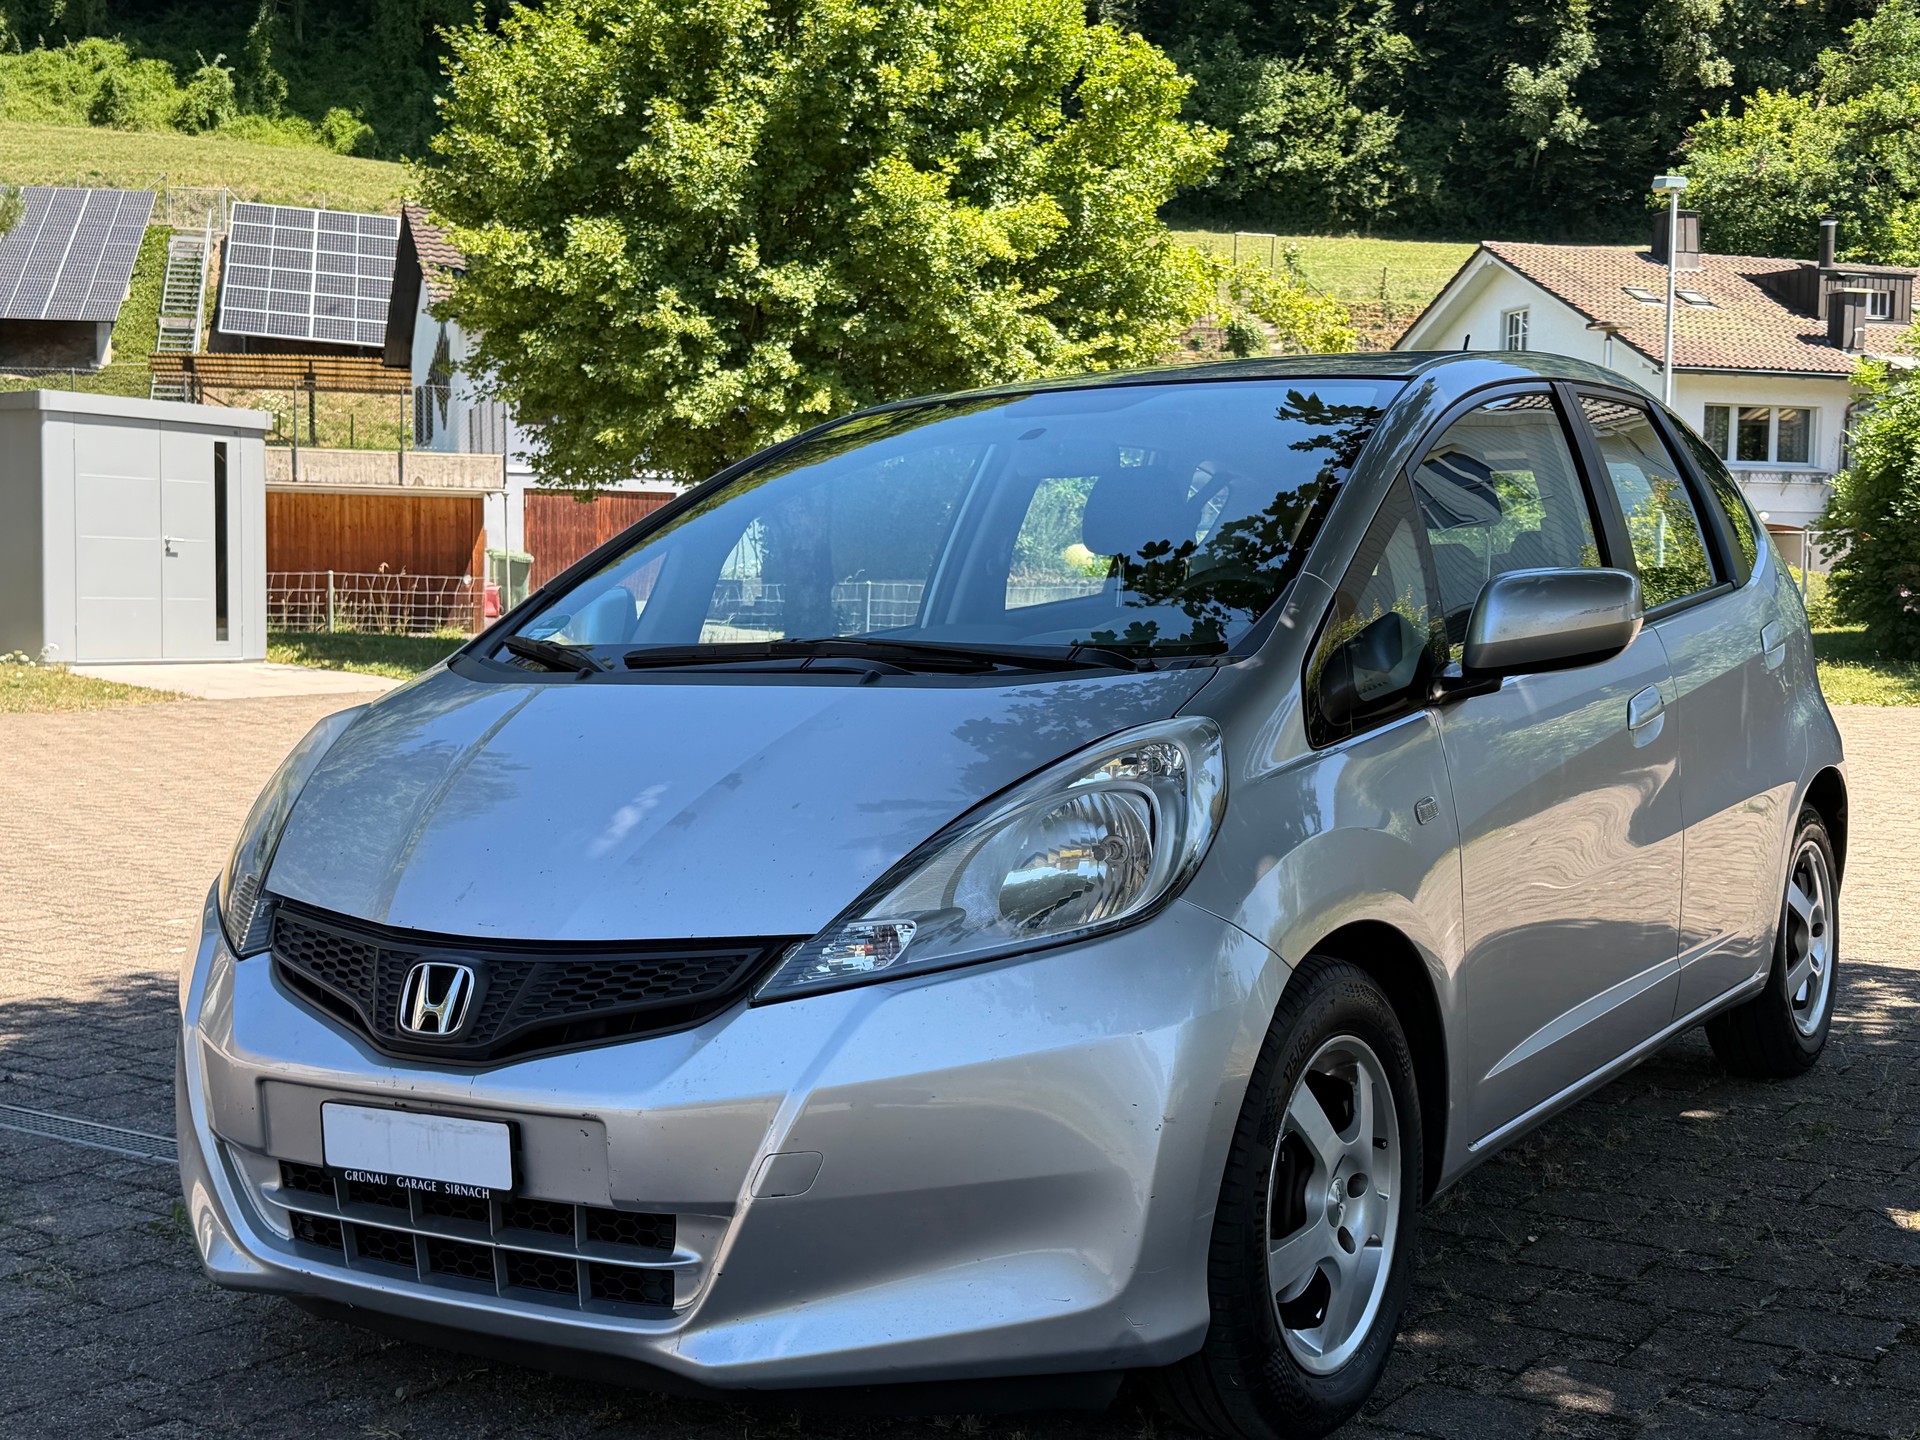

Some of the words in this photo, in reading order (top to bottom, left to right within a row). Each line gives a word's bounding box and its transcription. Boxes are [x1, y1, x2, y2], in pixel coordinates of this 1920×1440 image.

[1283, 1029, 1310, 1083] 175/65
[344, 1170, 388, 1185] GRÜNAU
[396, 1176, 437, 1192] GARAGE
[445, 1183, 490, 1199] SIRNACH
